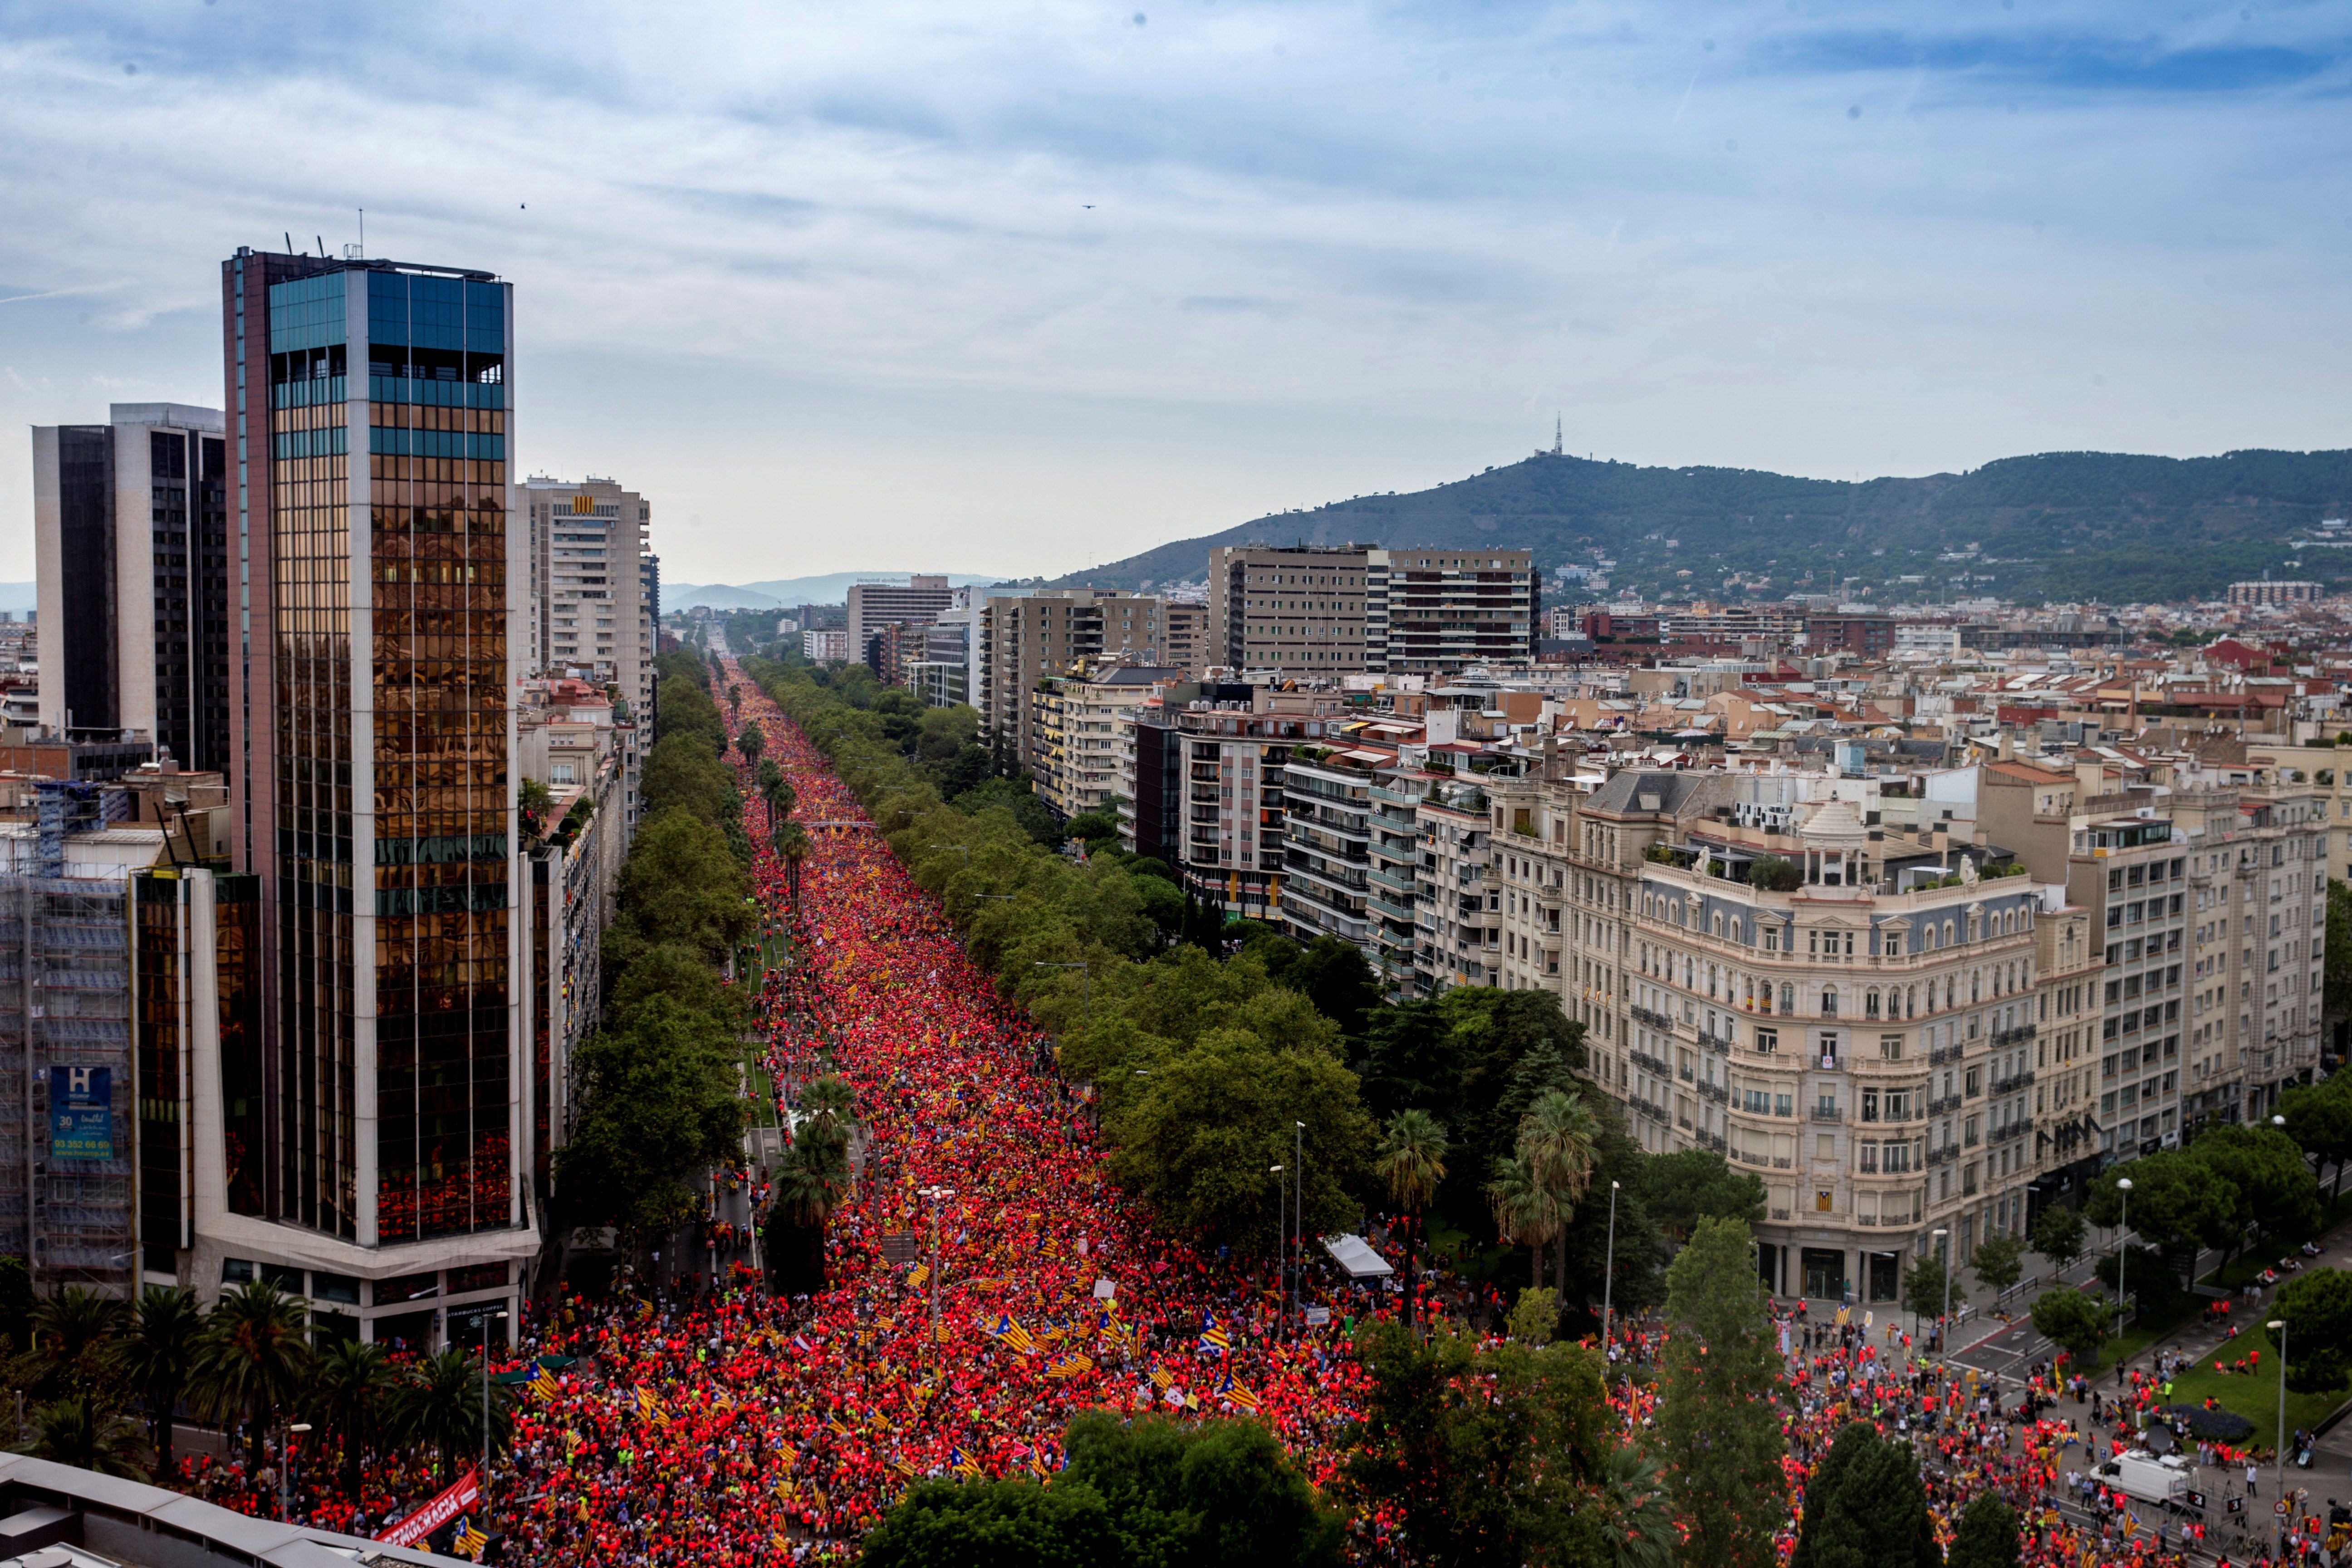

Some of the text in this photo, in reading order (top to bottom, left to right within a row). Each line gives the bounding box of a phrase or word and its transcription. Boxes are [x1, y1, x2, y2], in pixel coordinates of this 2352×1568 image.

[59, 1116, 73, 1126] 30
[54, 1139, 65, 1148] 93
[447, 1308, 481, 1318] STARBUCKS
[2195, 1494, 2203, 1505] 3
[2232, 1500, 2239, 1510] 3
